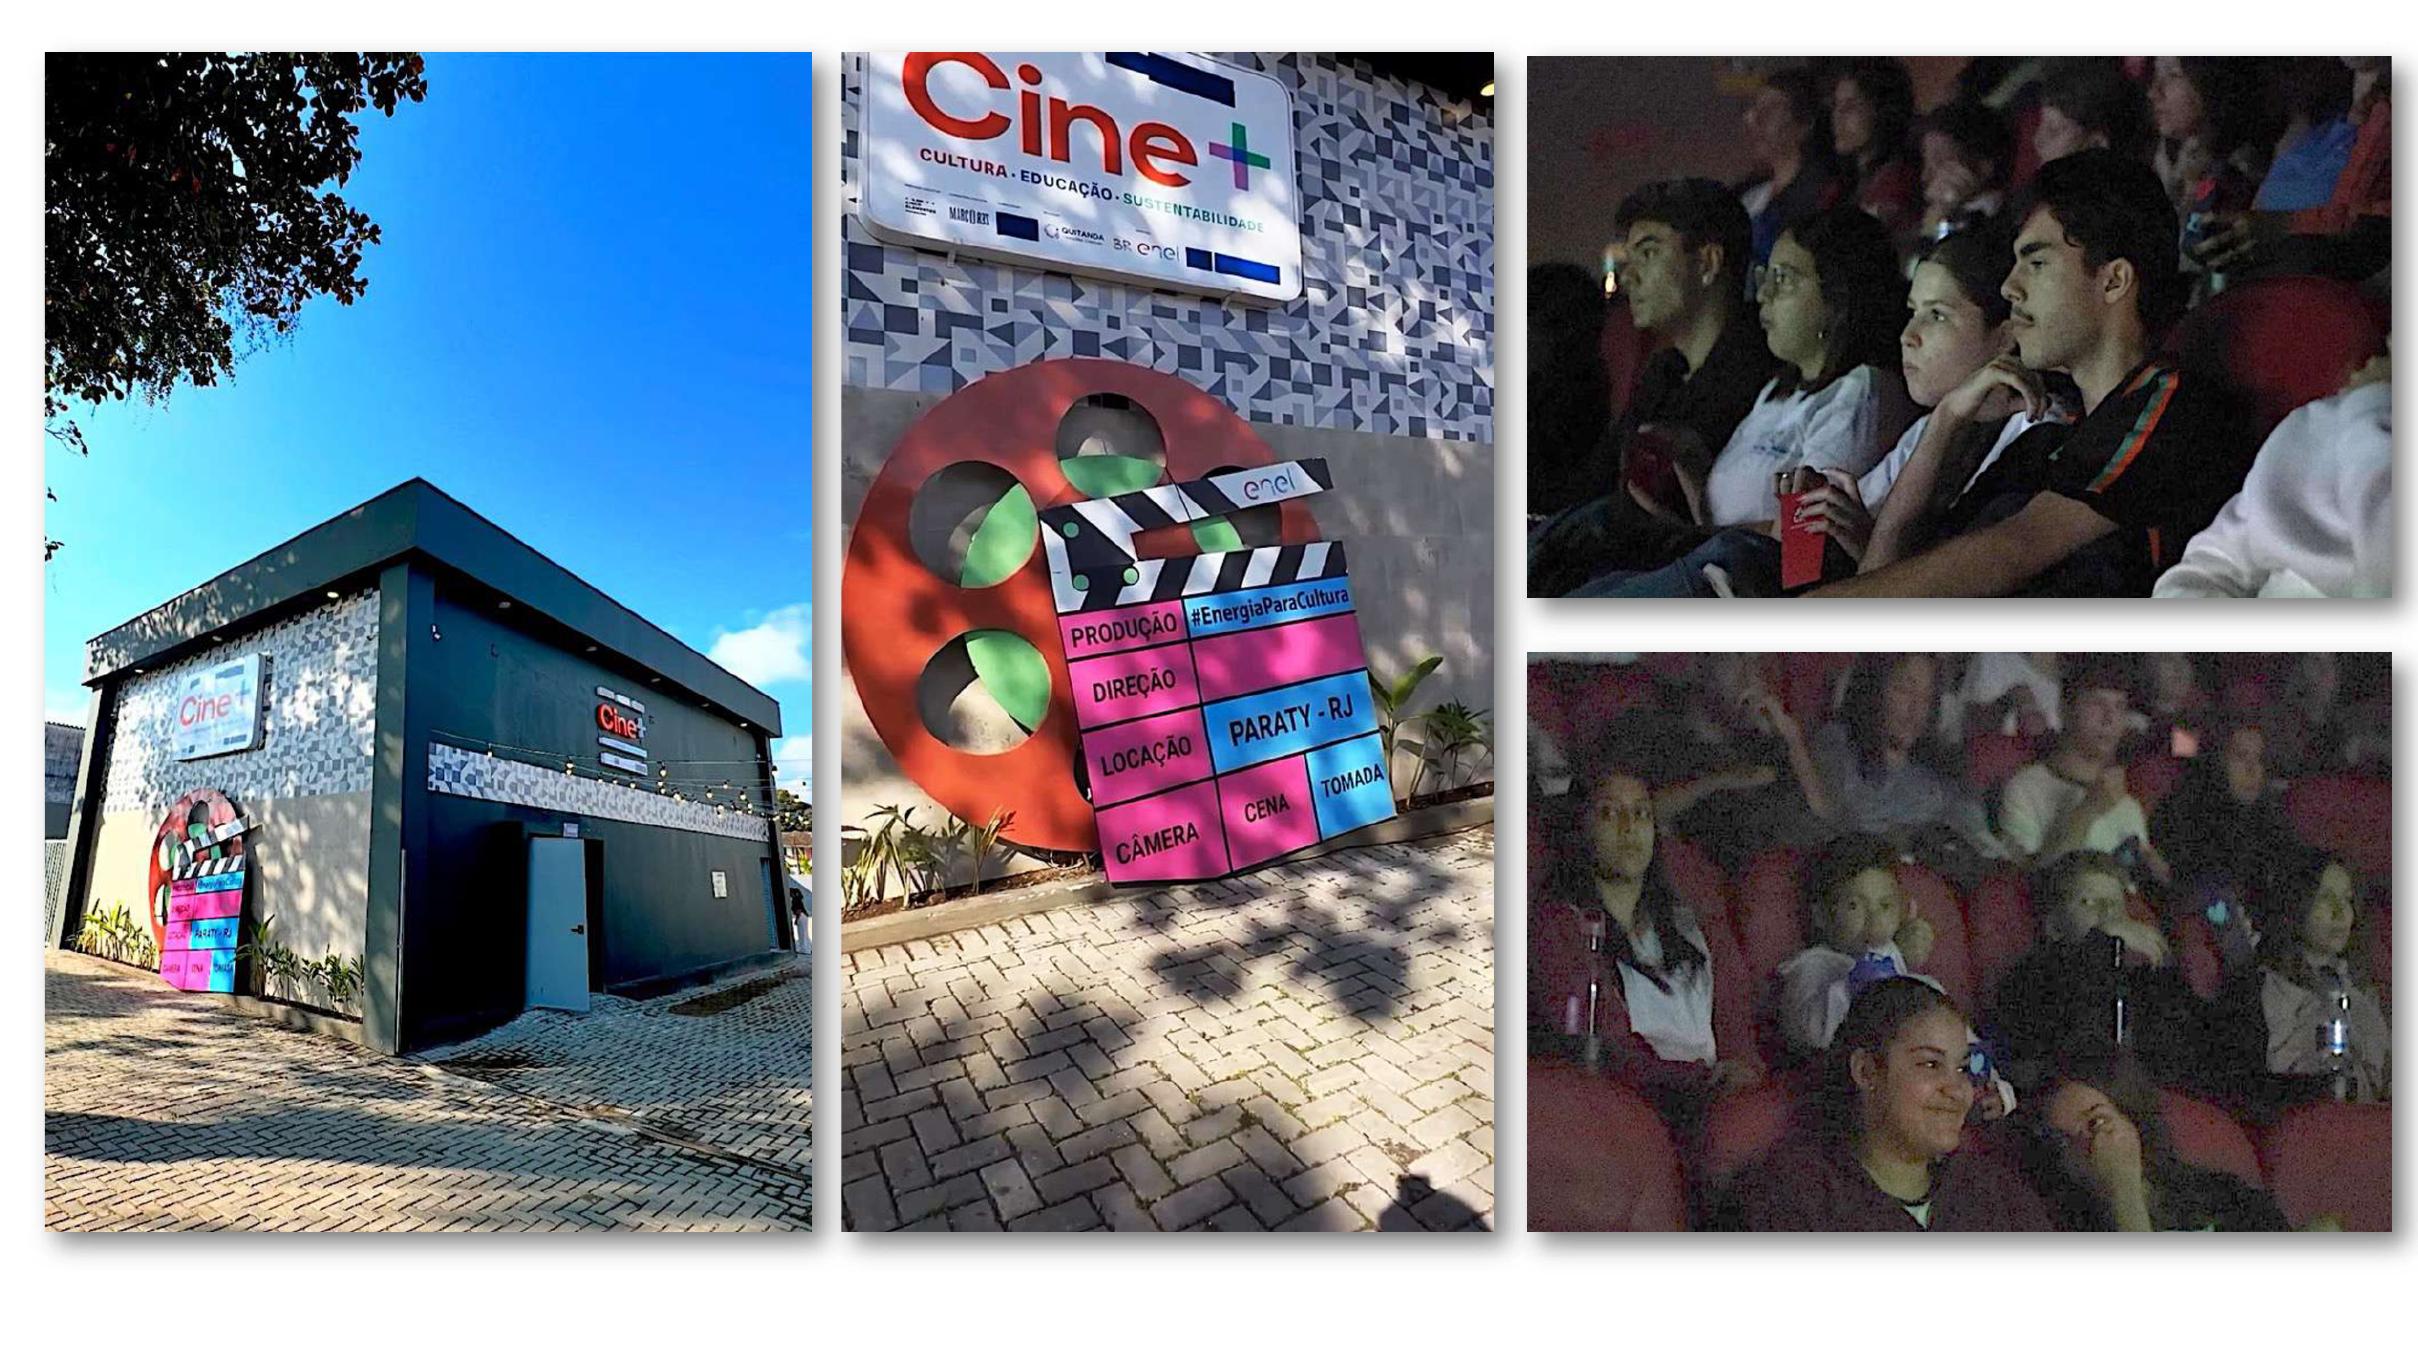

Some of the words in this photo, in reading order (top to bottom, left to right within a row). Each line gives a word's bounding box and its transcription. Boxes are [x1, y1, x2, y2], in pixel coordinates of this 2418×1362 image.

[920, 148, 1008, 179] CULTURA
[1020, 169, 1112, 201] EDUCAÇÃO
[1123, 192, 1264, 233] SUSTENTABILIDADE
[1137, 242, 1180, 261] enel
[1243, 468, 1296, 500] enel
[1191, 587, 1349, 626] #EnergiaParaCultura
[1070, 611, 1177, 649] PRODUÇÃO
[1092, 668, 1177, 703] DIREÇÃO
[1229, 703, 1311, 747] PARATY
[1330, 693, 1354, 722] RJ
[1100, 735, 1192, 777] LOCAÇÃO
[1321, 762, 1385, 798] TOMADA
[1245, 793, 1290, 824] CENA
[1115, 821, 1200, 866] CÂMERA
